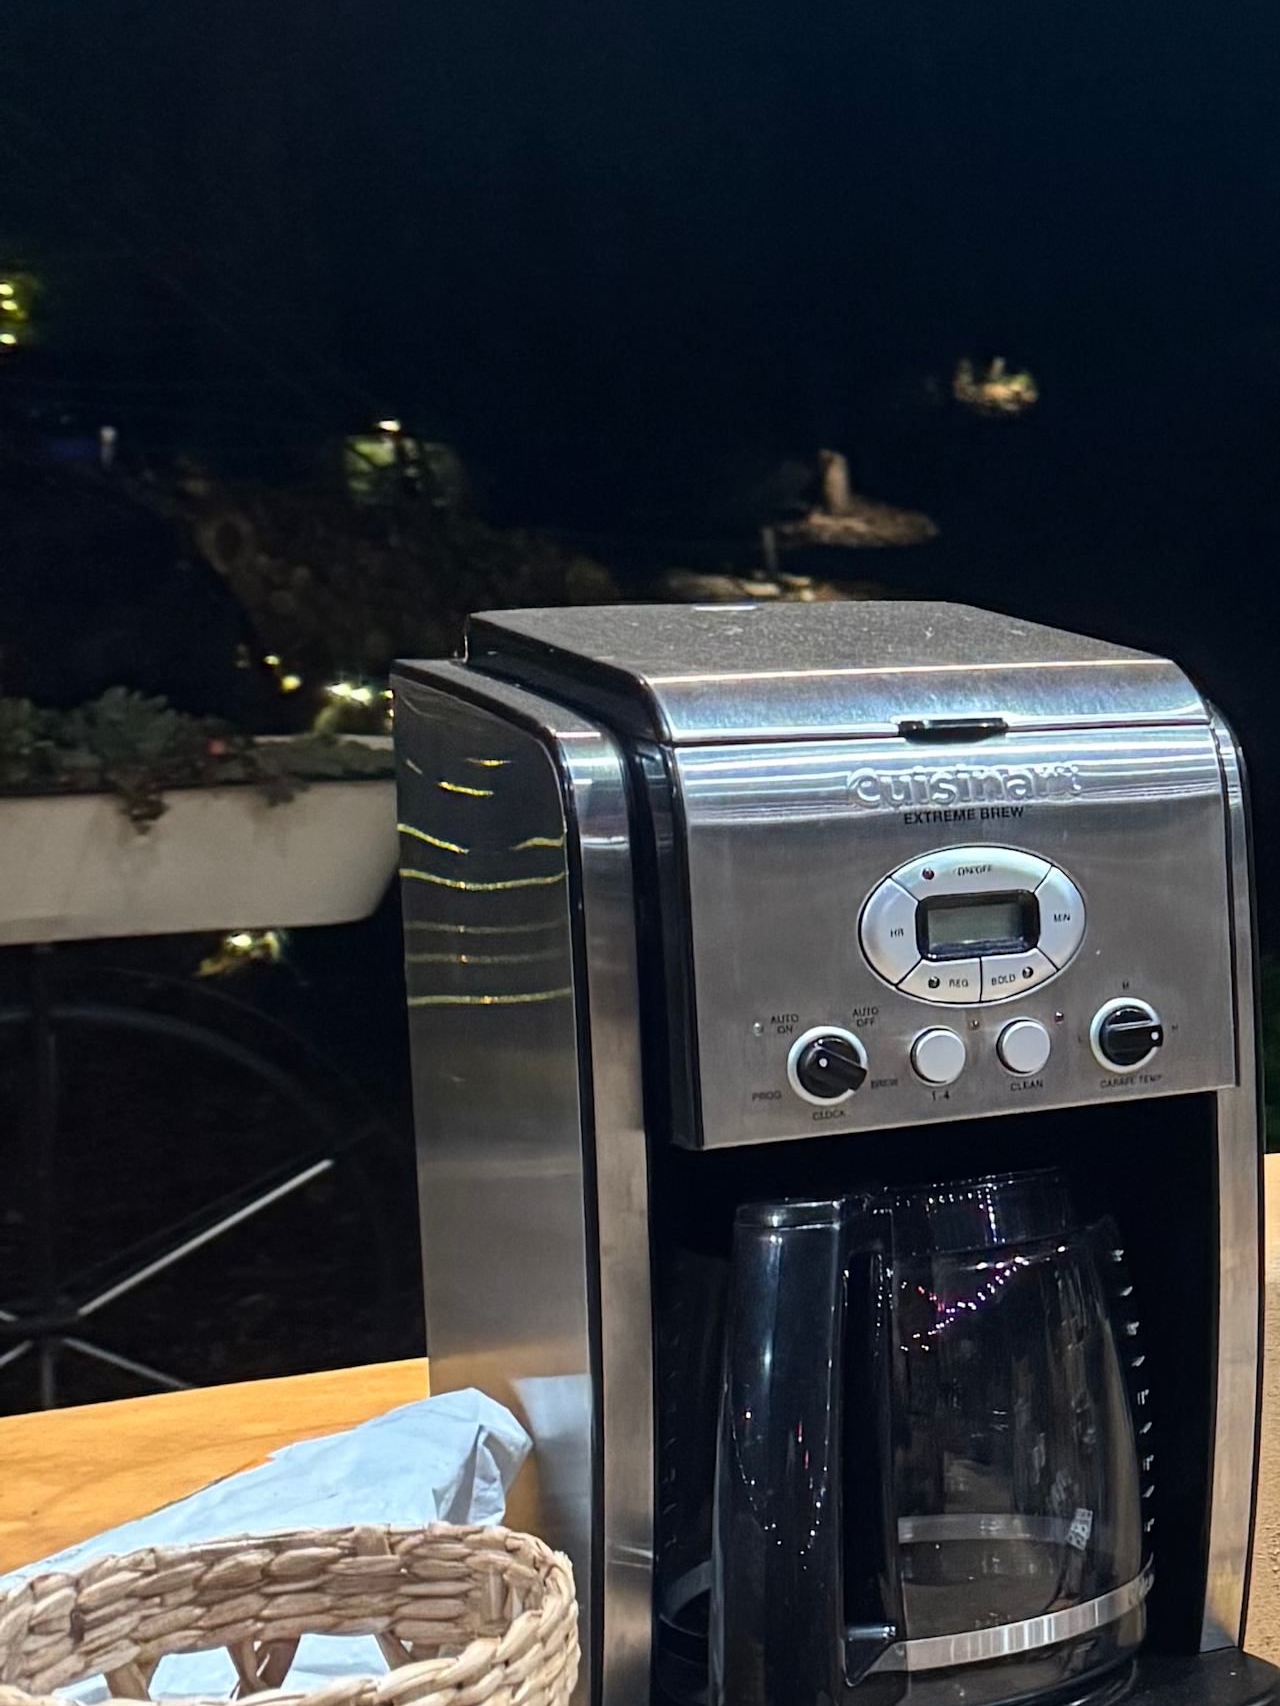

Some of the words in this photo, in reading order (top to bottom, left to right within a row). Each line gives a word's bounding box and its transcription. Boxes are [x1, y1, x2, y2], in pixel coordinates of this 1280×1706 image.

[904, 809, 976, 825] EXTREME
[980, 806, 1025, 820] BREW
[890, 928, 904, 938] HR
[949, 978, 969, 988] REG
[991, 974, 1016, 986] BOLD
[852, 1006, 879, 1018] AUTO
[771, 1013, 799, 1025] AUTO
[856, 1017, 876, 1028] OFF
[777, 1024, 793, 1035] ON
[1010, 1079, 1043, 1092] CLEAN
